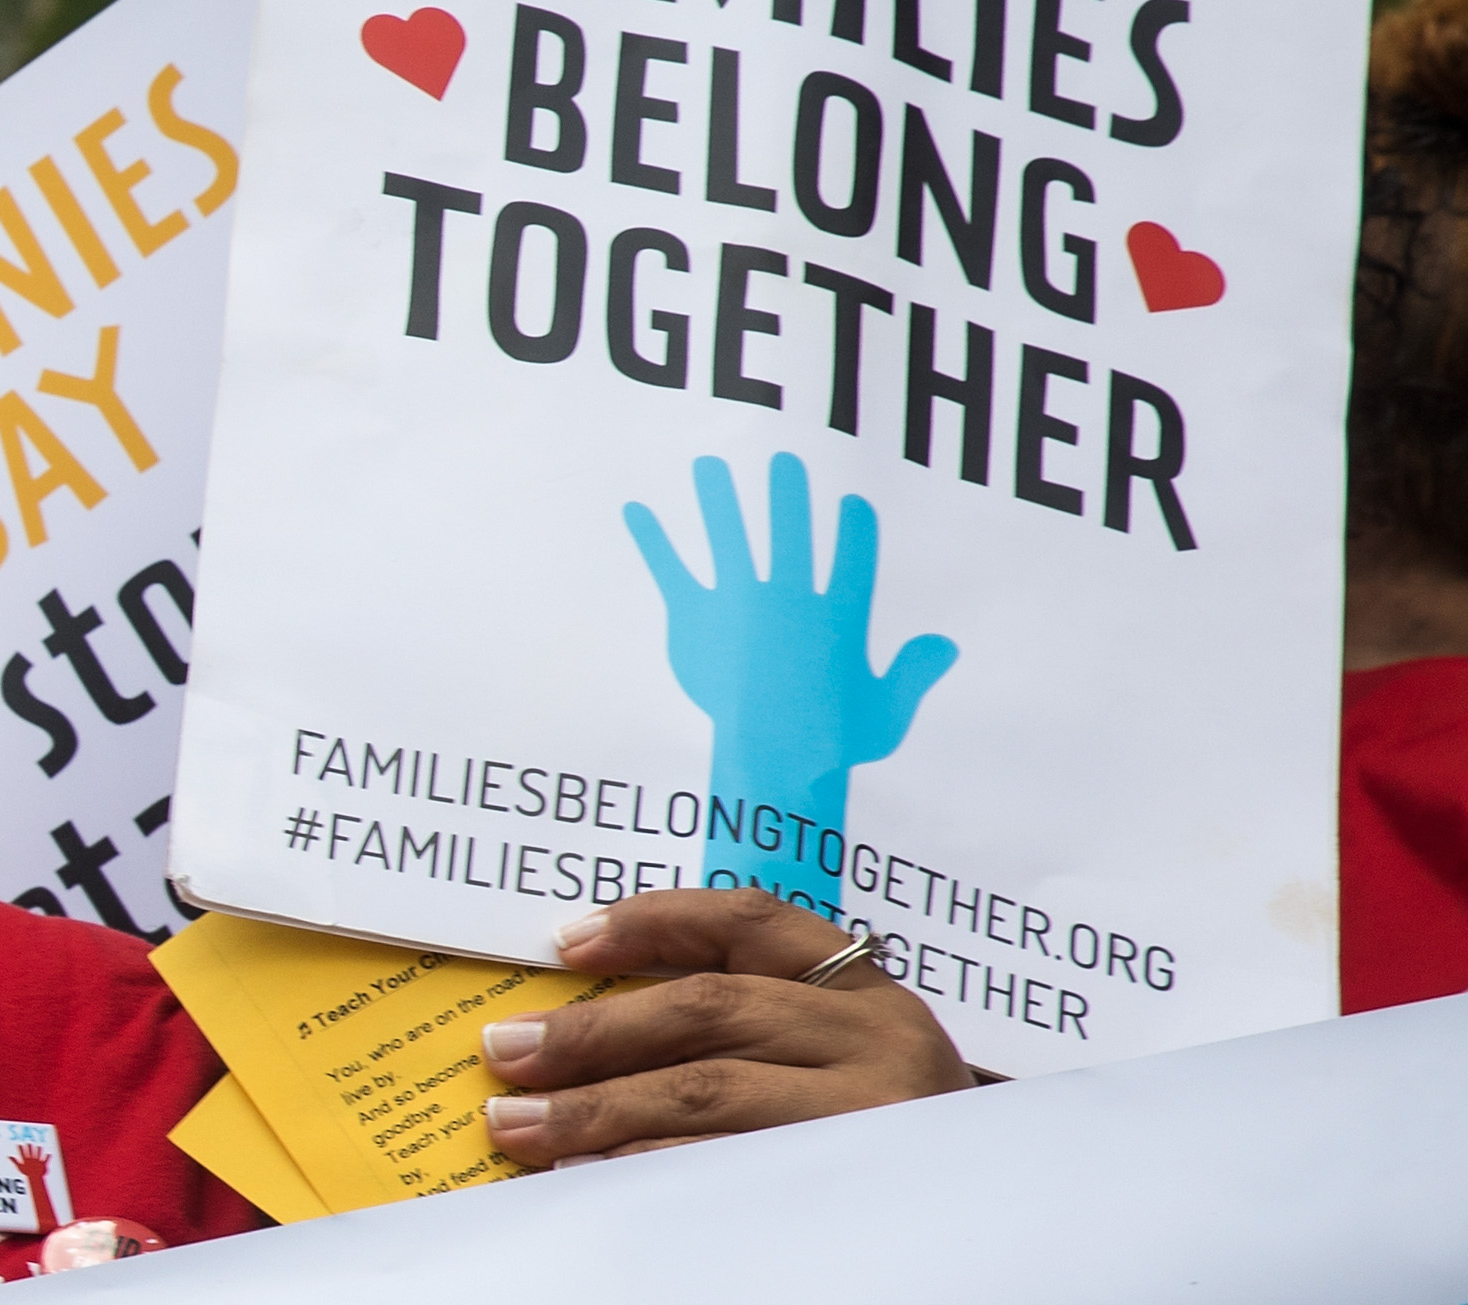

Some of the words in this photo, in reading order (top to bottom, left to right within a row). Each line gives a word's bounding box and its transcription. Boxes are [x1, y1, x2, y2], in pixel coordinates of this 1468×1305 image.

[505, 3, 1097, 324] BELONG
[383, 171, 1200, 553] TOGETHER
[0, 526, 202, 779] sto
[293, 728, 1175, 994] FAMILIESBELONGTOGETHER.ORG
[312, 992, 373, 1028] Teach
[370, 965, 419, 995] Your
[367, 1038, 405, 1062] who
[405, 1022, 435, 1042] are
[435, 1009, 459, 1026] on
[456, 994, 488, 1014] the
[486, 970, 526, 998] road
[8, 1124, 48, 1144] SAY
[358, 1100, 393, 1126] And
[394, 1090, 416, 1106] so
[414, 1054, 482, 1094] become
[384, 1131, 439, 1164] Teach
[438, 1111, 477, 1140] your
